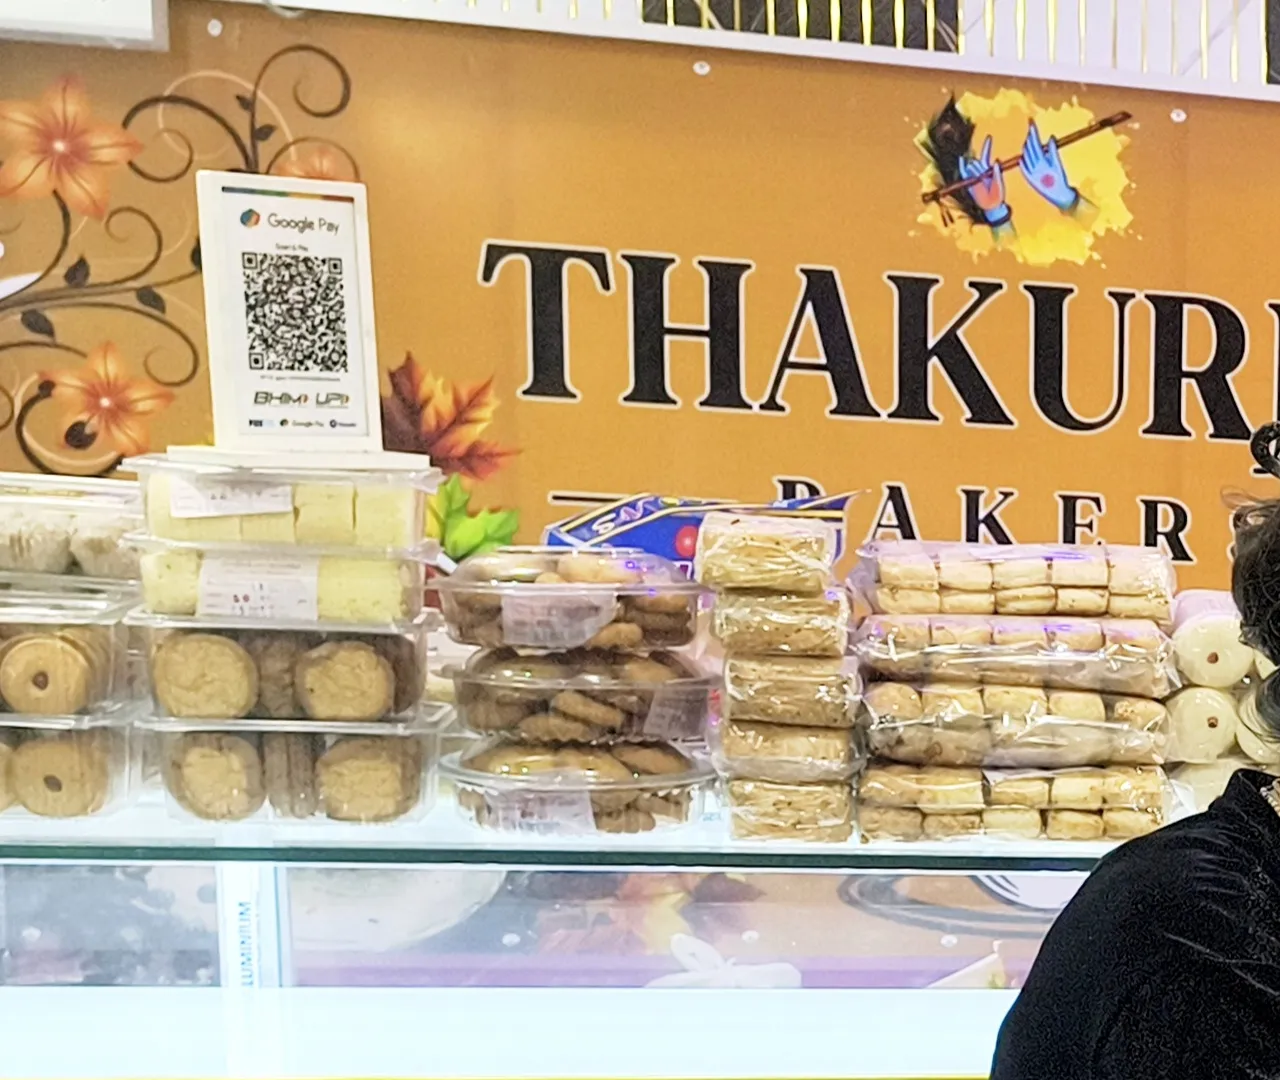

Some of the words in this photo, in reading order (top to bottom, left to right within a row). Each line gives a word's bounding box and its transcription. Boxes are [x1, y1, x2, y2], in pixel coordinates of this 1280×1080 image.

[267, 212, 315, 234] Google
[318, 217, 340, 236] Pay
[777, 478, 1196, 562] AKER
